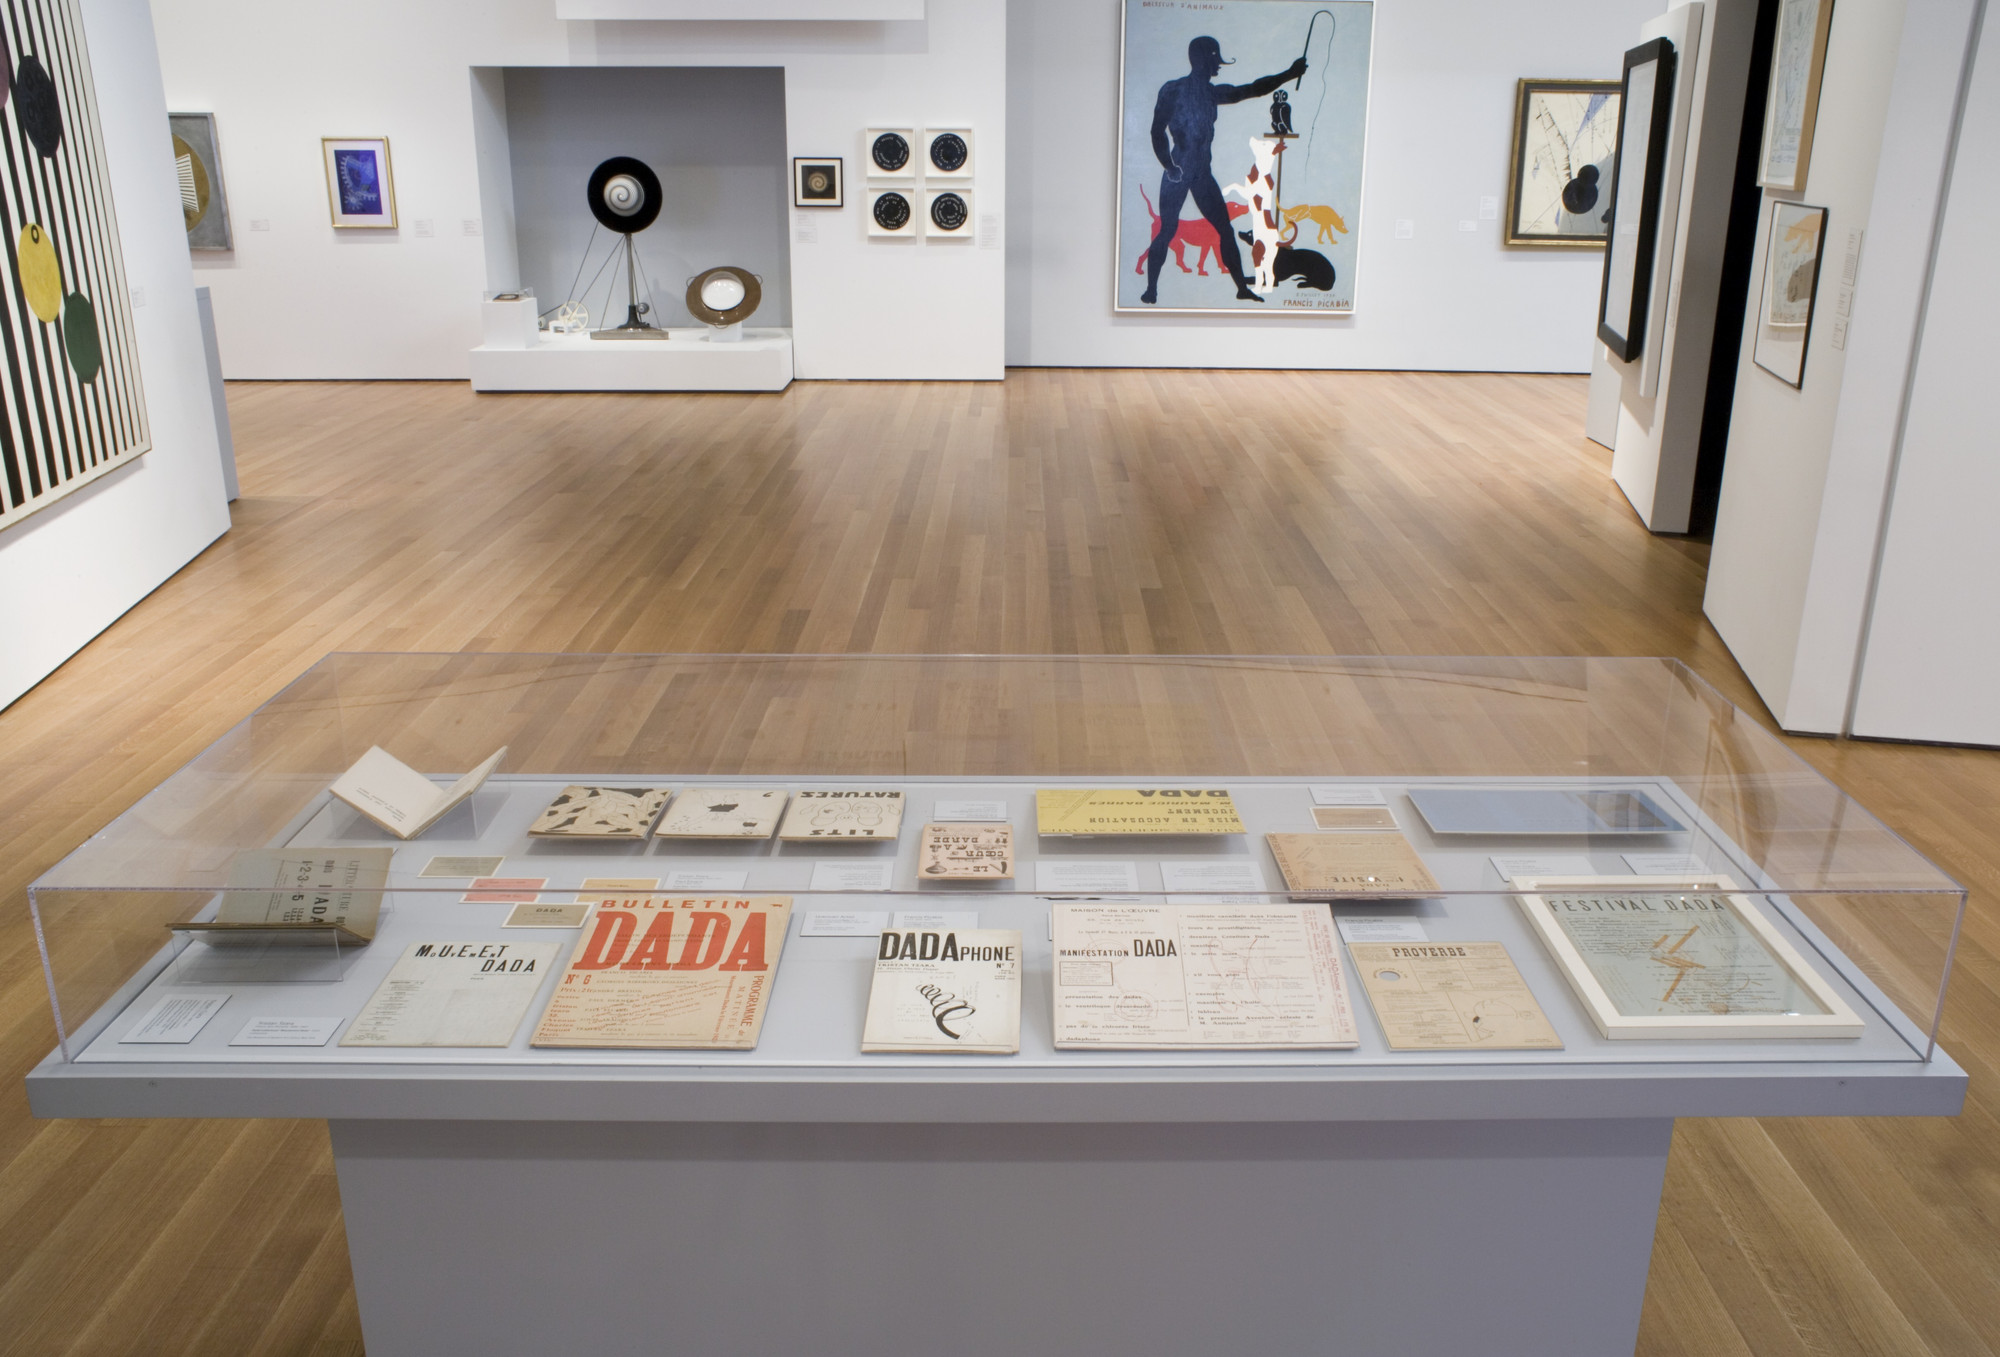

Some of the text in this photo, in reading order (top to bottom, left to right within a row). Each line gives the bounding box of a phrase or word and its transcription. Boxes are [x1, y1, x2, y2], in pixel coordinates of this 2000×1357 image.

[1283, 298, 1351, 308] FRANCIS PICABIA
[800, 791, 901, 799] RATURES
[1136, 790, 1228, 798] DADA
[973, 865, 989, 873] LE
[601, 900, 750, 909] BULLETIN
[1549, 899, 1725, 912] FESTIVAL DADA
[572, 911, 770, 972] DADA
[878, 932, 1015, 961] DADAPHONE
[414, 944, 510, 958] MOUVEMENT
[1060, 939, 1178, 957] MANIFESTATION DADA
[1391, 947, 1467, 957] PROVERBE
[481, 959, 537, 972] DADA
[583, 974, 592, 985] 6
[740, 975, 764, 1027] PROGRAMME
